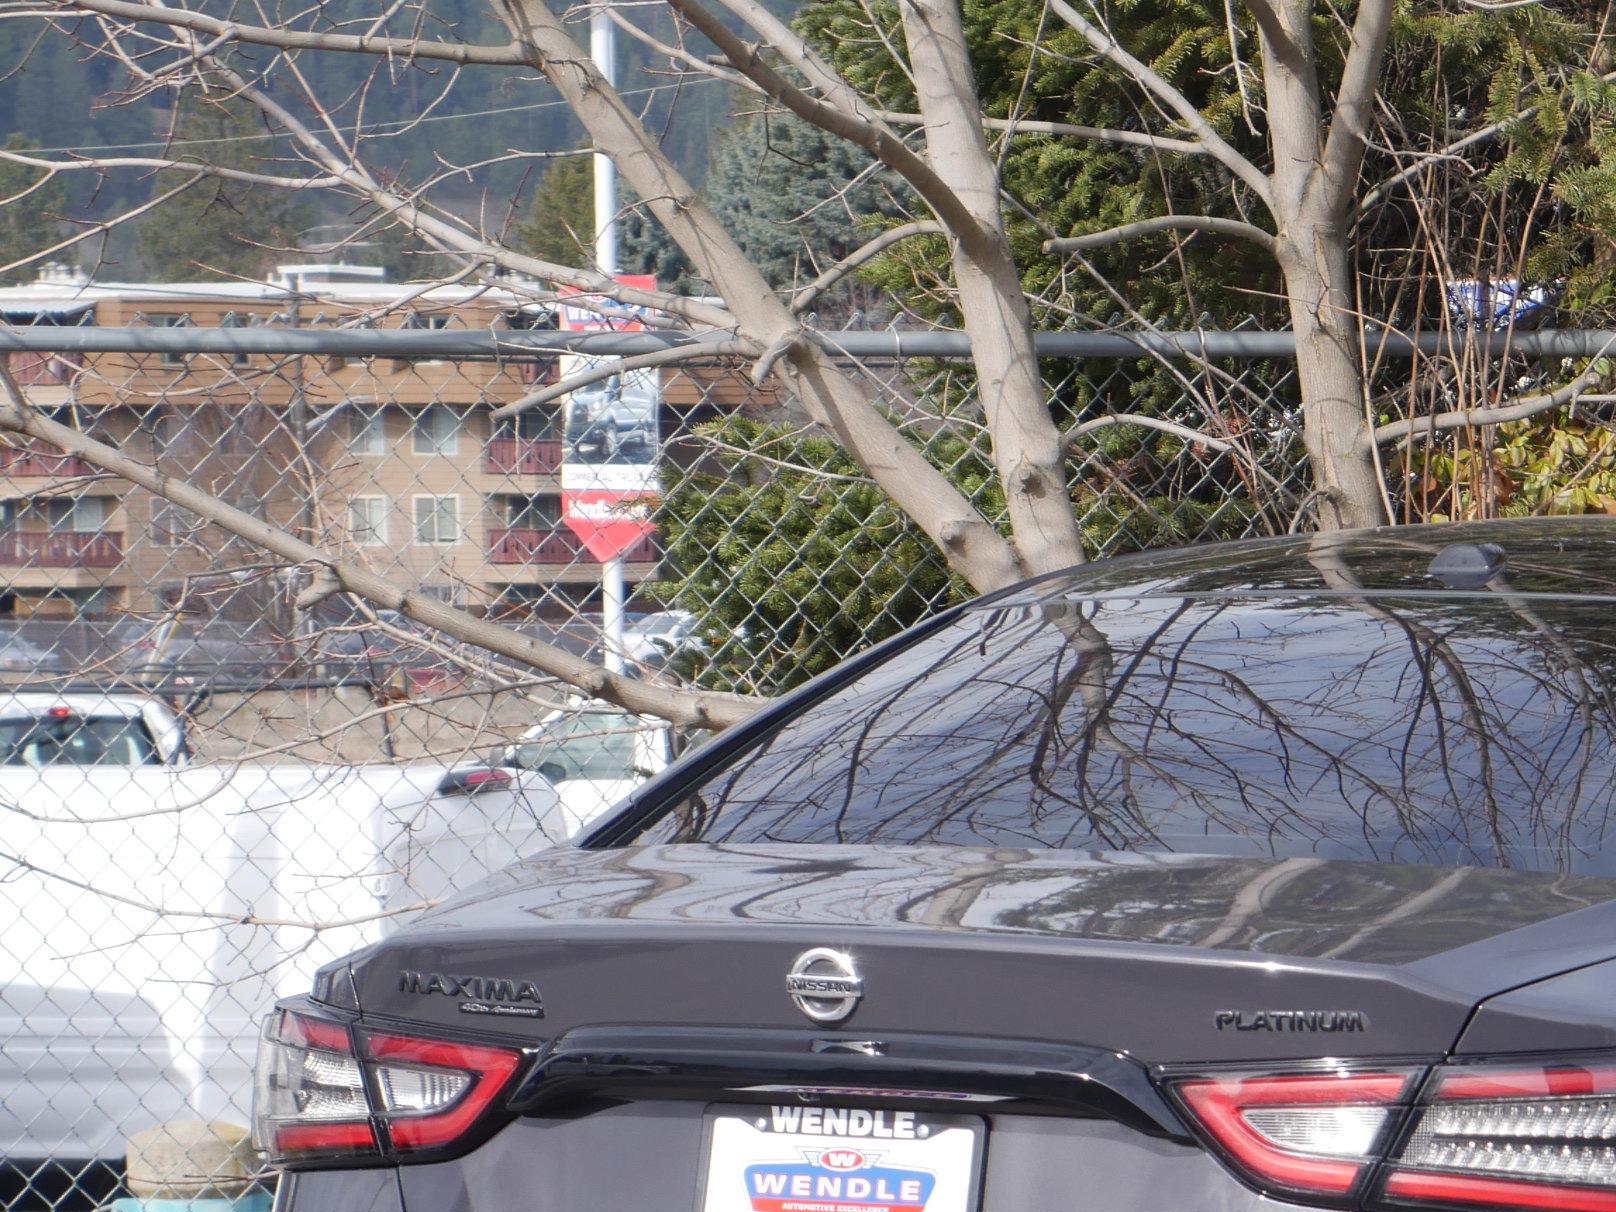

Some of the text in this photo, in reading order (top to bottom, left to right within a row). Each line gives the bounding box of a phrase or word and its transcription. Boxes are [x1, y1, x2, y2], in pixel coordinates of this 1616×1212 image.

[400, 970, 543, 1003] MAXIMA
[791, 979, 851, 992] NISSAN
[461, 1002, 489, 1012] 40th
[1214, 1010, 1369, 1032] PLATINUM
[771, 1105, 915, 1138] WENDLE
[828, 1152, 857, 1167] W
[753, 1173, 921, 1201] WENDLE
[782, 1202, 836, 1212] AUTOMOTIVE
